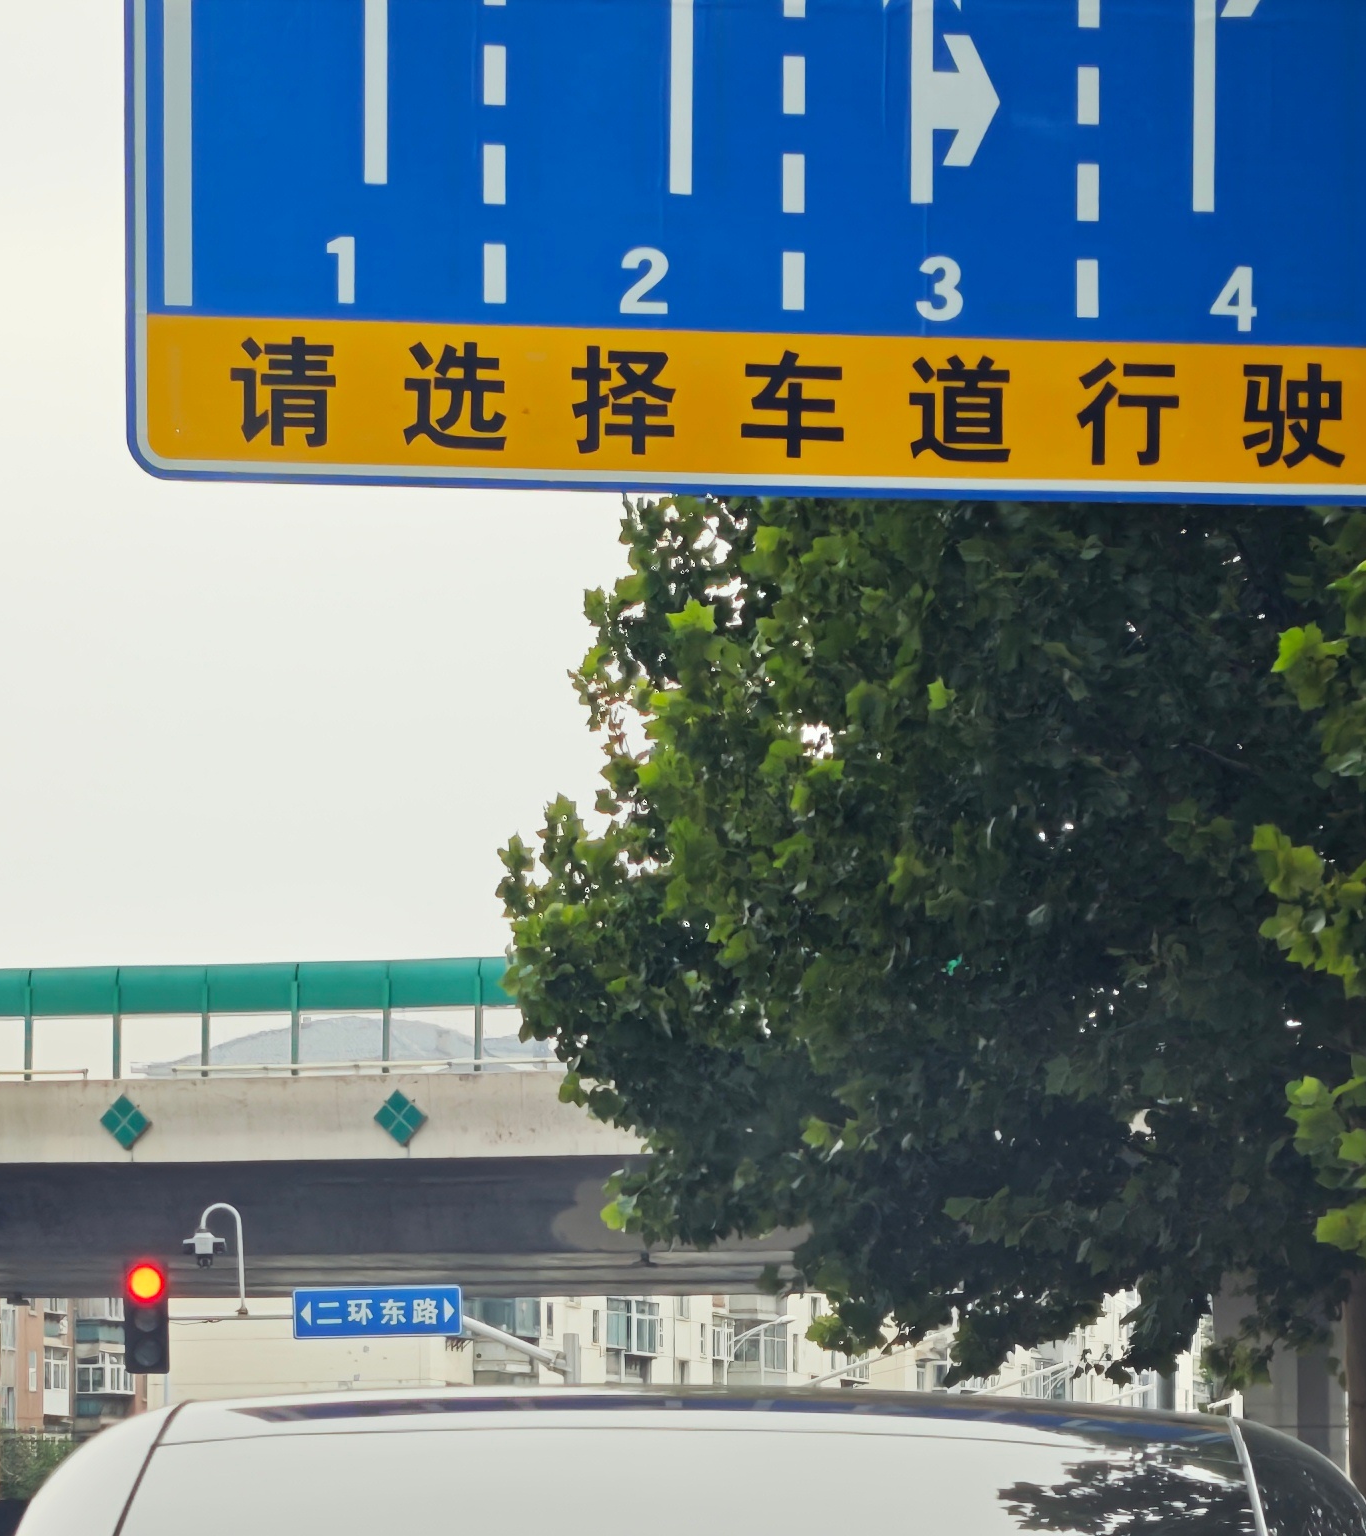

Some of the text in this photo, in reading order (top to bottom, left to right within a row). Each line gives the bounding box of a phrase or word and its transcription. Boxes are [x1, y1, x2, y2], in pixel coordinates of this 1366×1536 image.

[326, 237, 1257, 331] 1 2 3 4
[229, 337, 1346, 468] 请选择车道行驶
[316, 1298, 438, 1326] 二环东路
